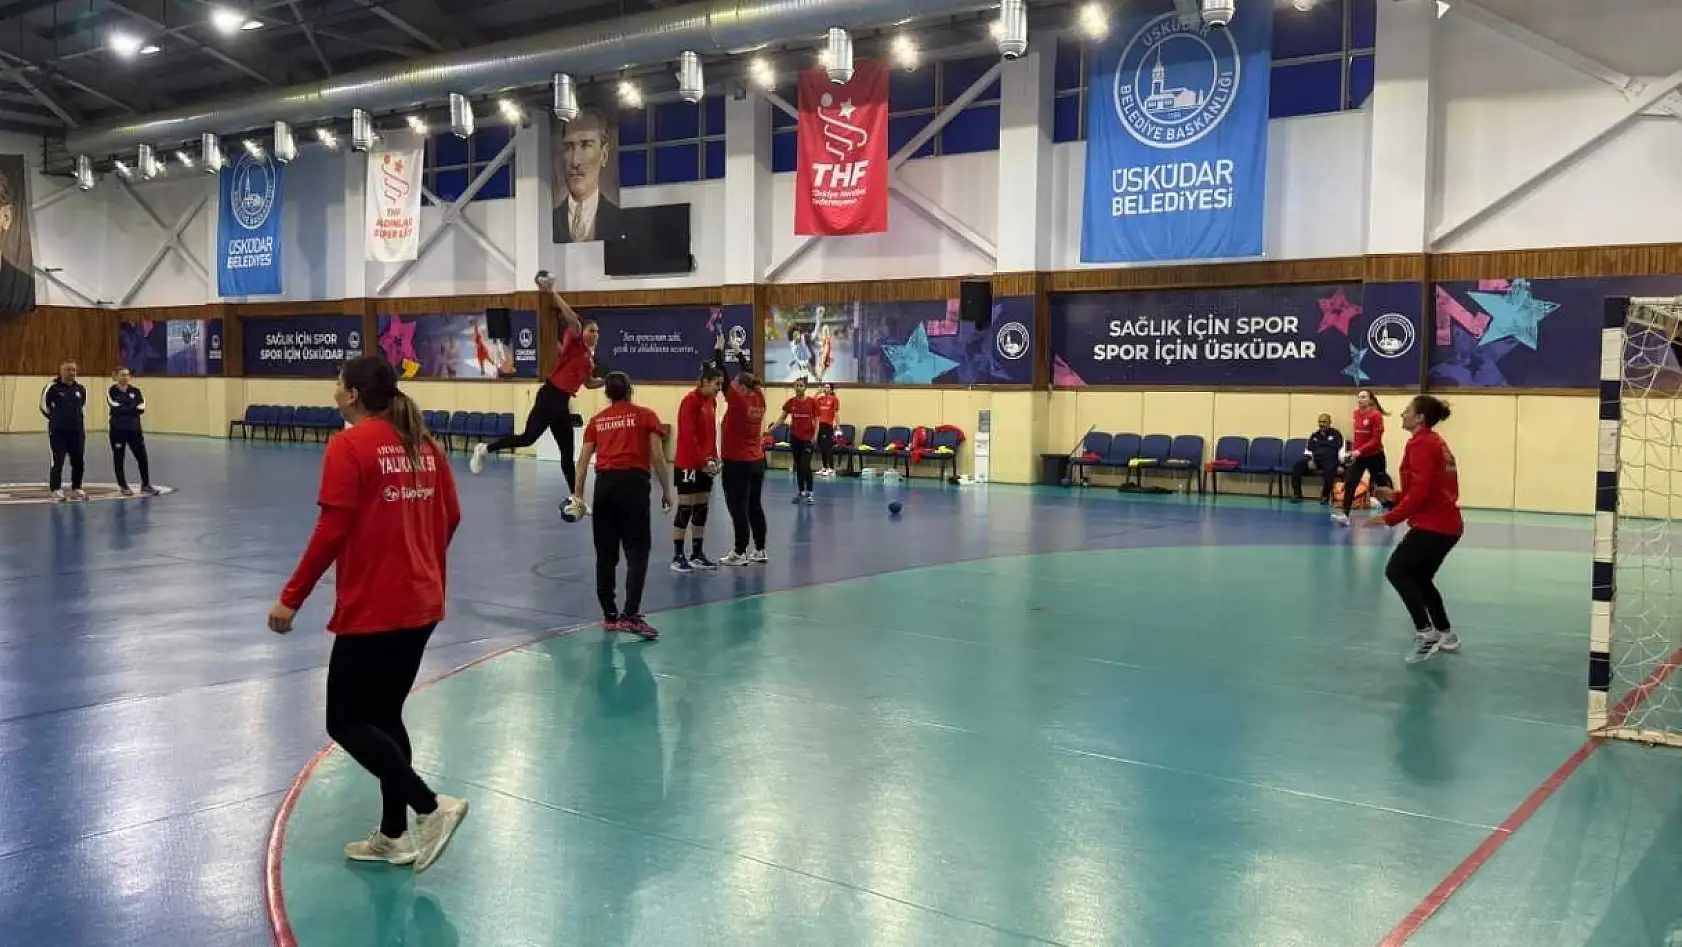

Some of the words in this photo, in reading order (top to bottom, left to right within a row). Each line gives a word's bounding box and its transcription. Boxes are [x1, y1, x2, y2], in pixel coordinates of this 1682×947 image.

[811, 160, 869, 188] THF
[1112, 159, 1234, 193] ÜSKÜDAR
[1109, 316, 1181, 337] SAĞLIK
[1187, 315, 1229, 340] İÇİN
[1236, 316, 1299, 336] SPOR
[1093, 343, 1149, 360] SPOR
[1155, 339, 1197, 365] İÇİN
[1204, 339, 1316, 360] ÜSKÜDAR
[681, 469, 696, 483] 14
